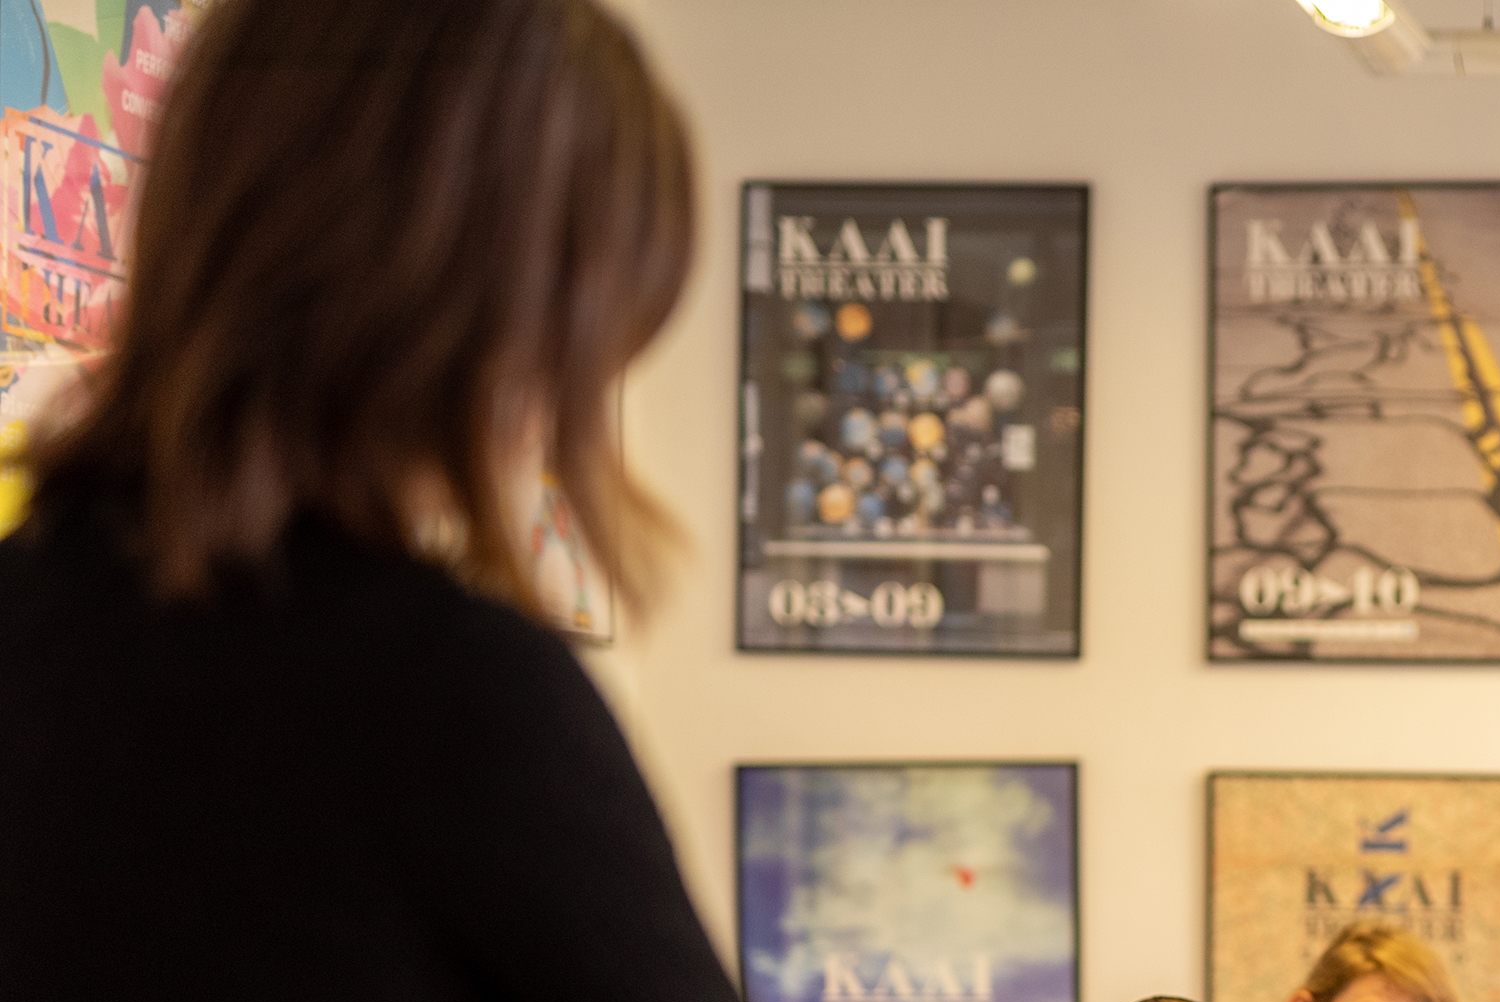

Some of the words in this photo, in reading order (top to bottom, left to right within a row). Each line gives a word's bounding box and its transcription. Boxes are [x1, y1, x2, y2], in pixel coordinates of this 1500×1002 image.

[22, 133, 122, 262] KA
[778, 215, 950, 263] KAAI
[1246, 217, 1421, 266] KAAI
[778, 267, 950, 298] THEATER
[822, 952, 995, 996] KAAI
